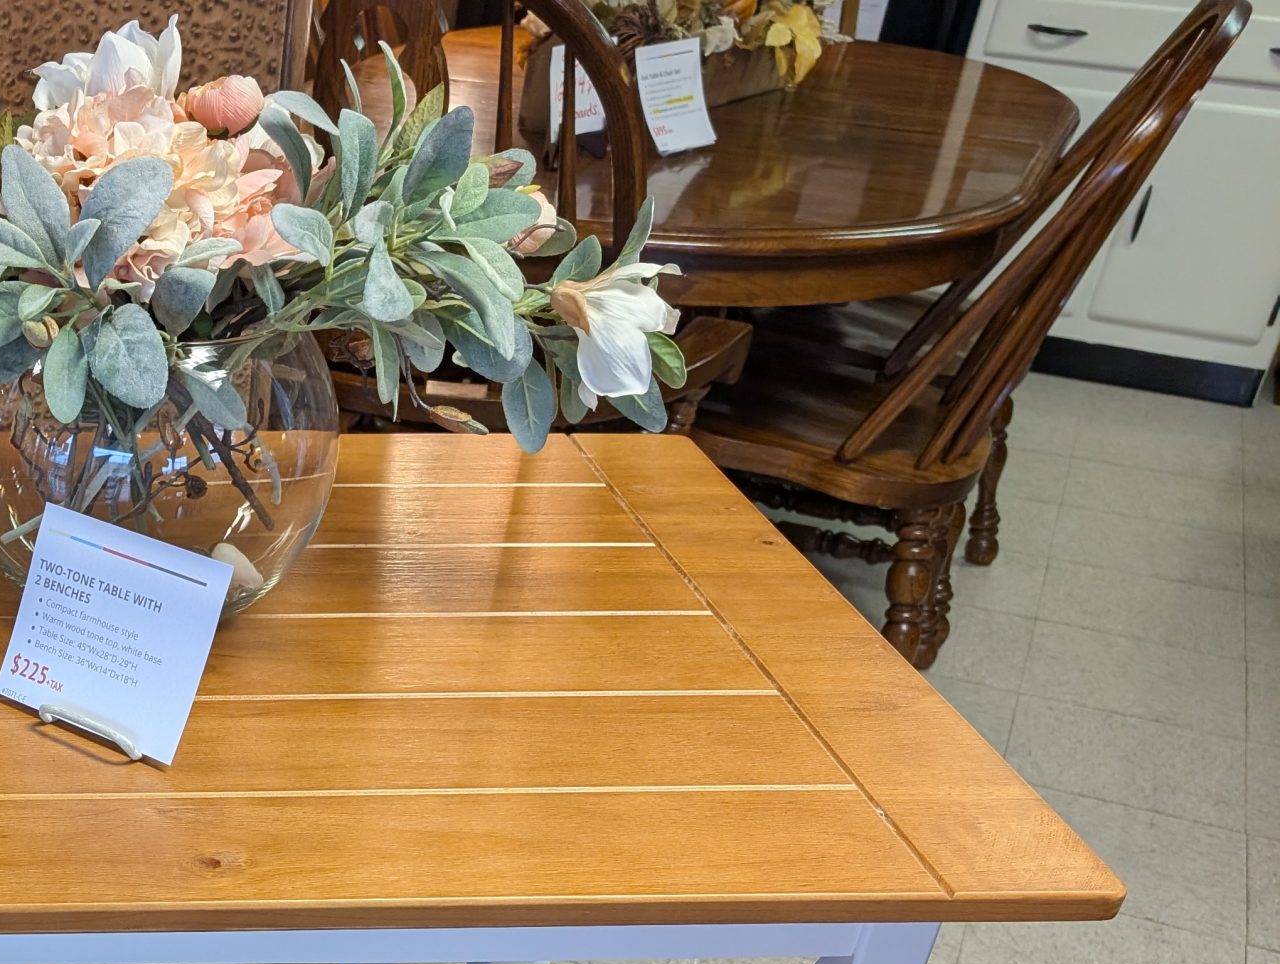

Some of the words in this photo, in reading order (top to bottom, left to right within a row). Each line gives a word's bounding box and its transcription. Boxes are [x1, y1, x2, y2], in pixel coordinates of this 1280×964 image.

[35, 574, 42, 586] 2
[43, 577, 92, 604] BENCHES
[40, 558, 96, 588] TWO-TONE
[98, 580, 131, 602] TABLE
[133, 593, 163, 613] WITH
[39, 625, 58, 640] Table
[59, 634, 75, 647] Size:
[46, 598, 79, 618] Compact
[79, 611, 120, 633] farmhouse
[121, 628, 139, 641] style
[35, 639, 57, 655] Bench
[57, 649, 75, 662] Size:
[42, 611, 64, 628] Warm
[65, 621, 86, 636] wood
[87, 630, 104, 643] tone
[105, 637, 119, 650] top,
[121, 644, 143, 658] white
[143, 651, 163, 666] base
